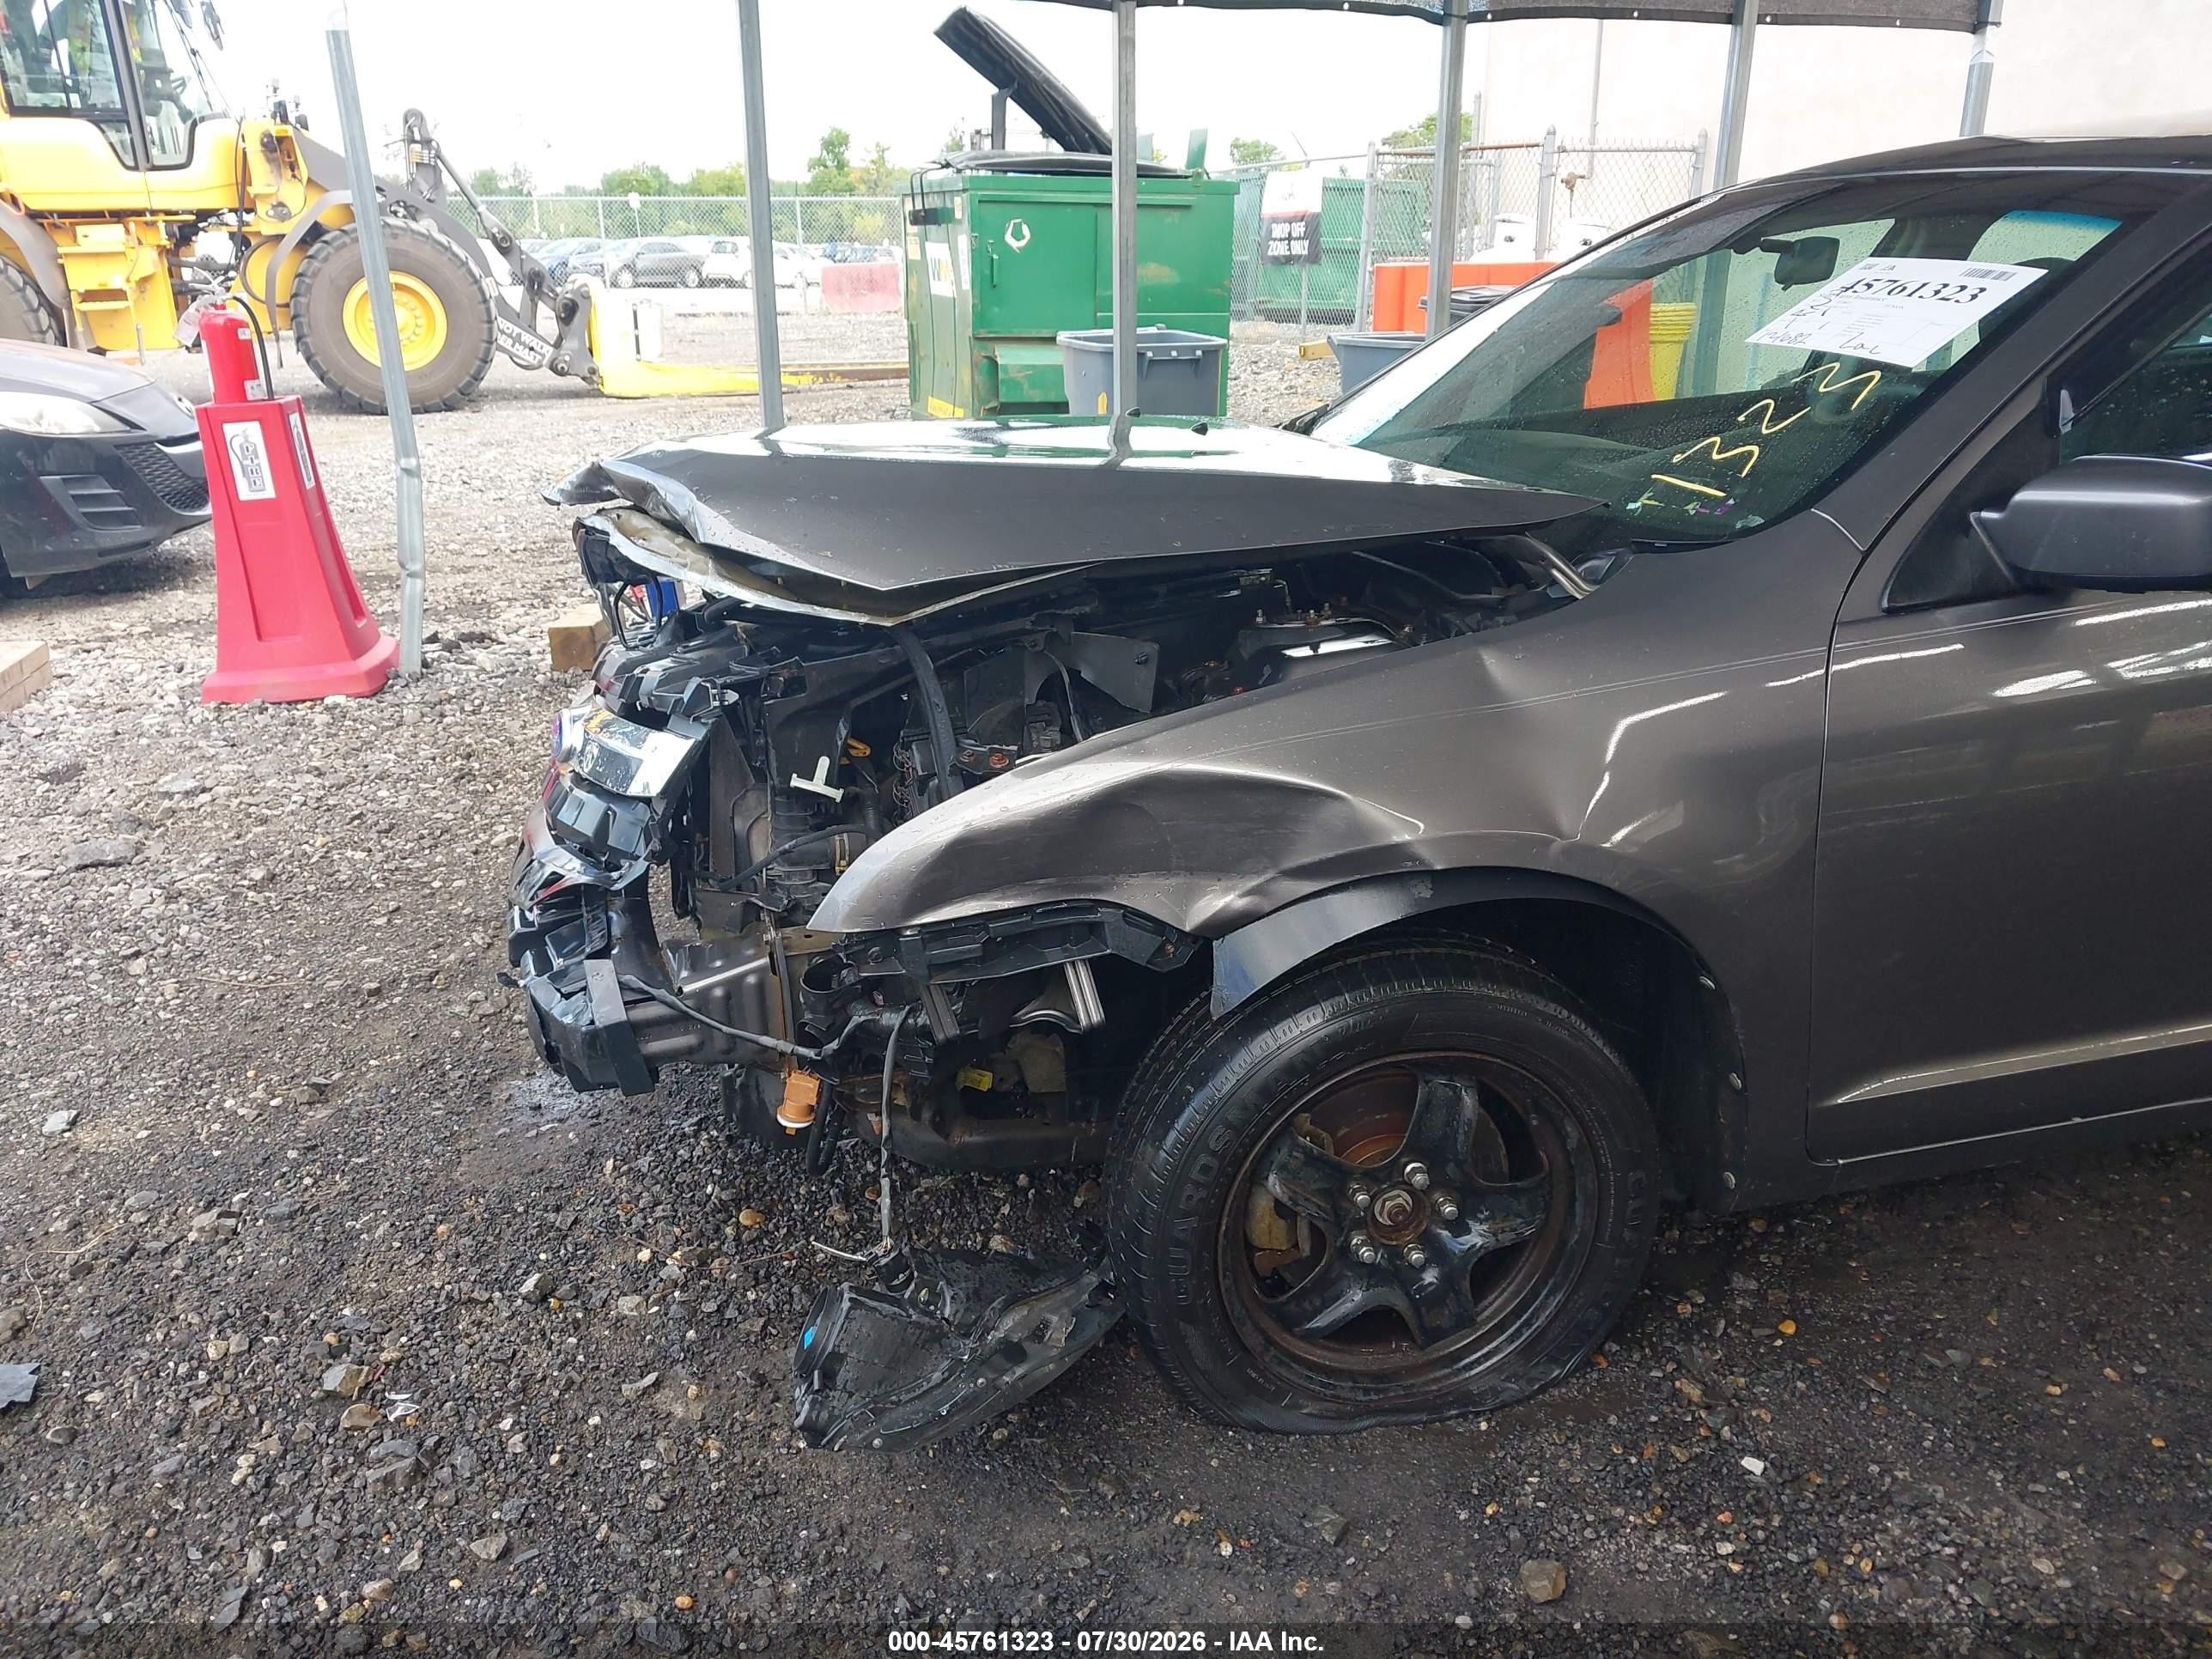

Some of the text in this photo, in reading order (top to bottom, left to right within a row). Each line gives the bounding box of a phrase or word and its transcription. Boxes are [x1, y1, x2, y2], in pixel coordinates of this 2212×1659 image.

[1291, 221, 1306, 238] OFF
[1267, 239, 1310, 256] ZONE ONLY
[1839, 277, 1988, 304] 45761323
[514, 342, 542, 364] MAST
